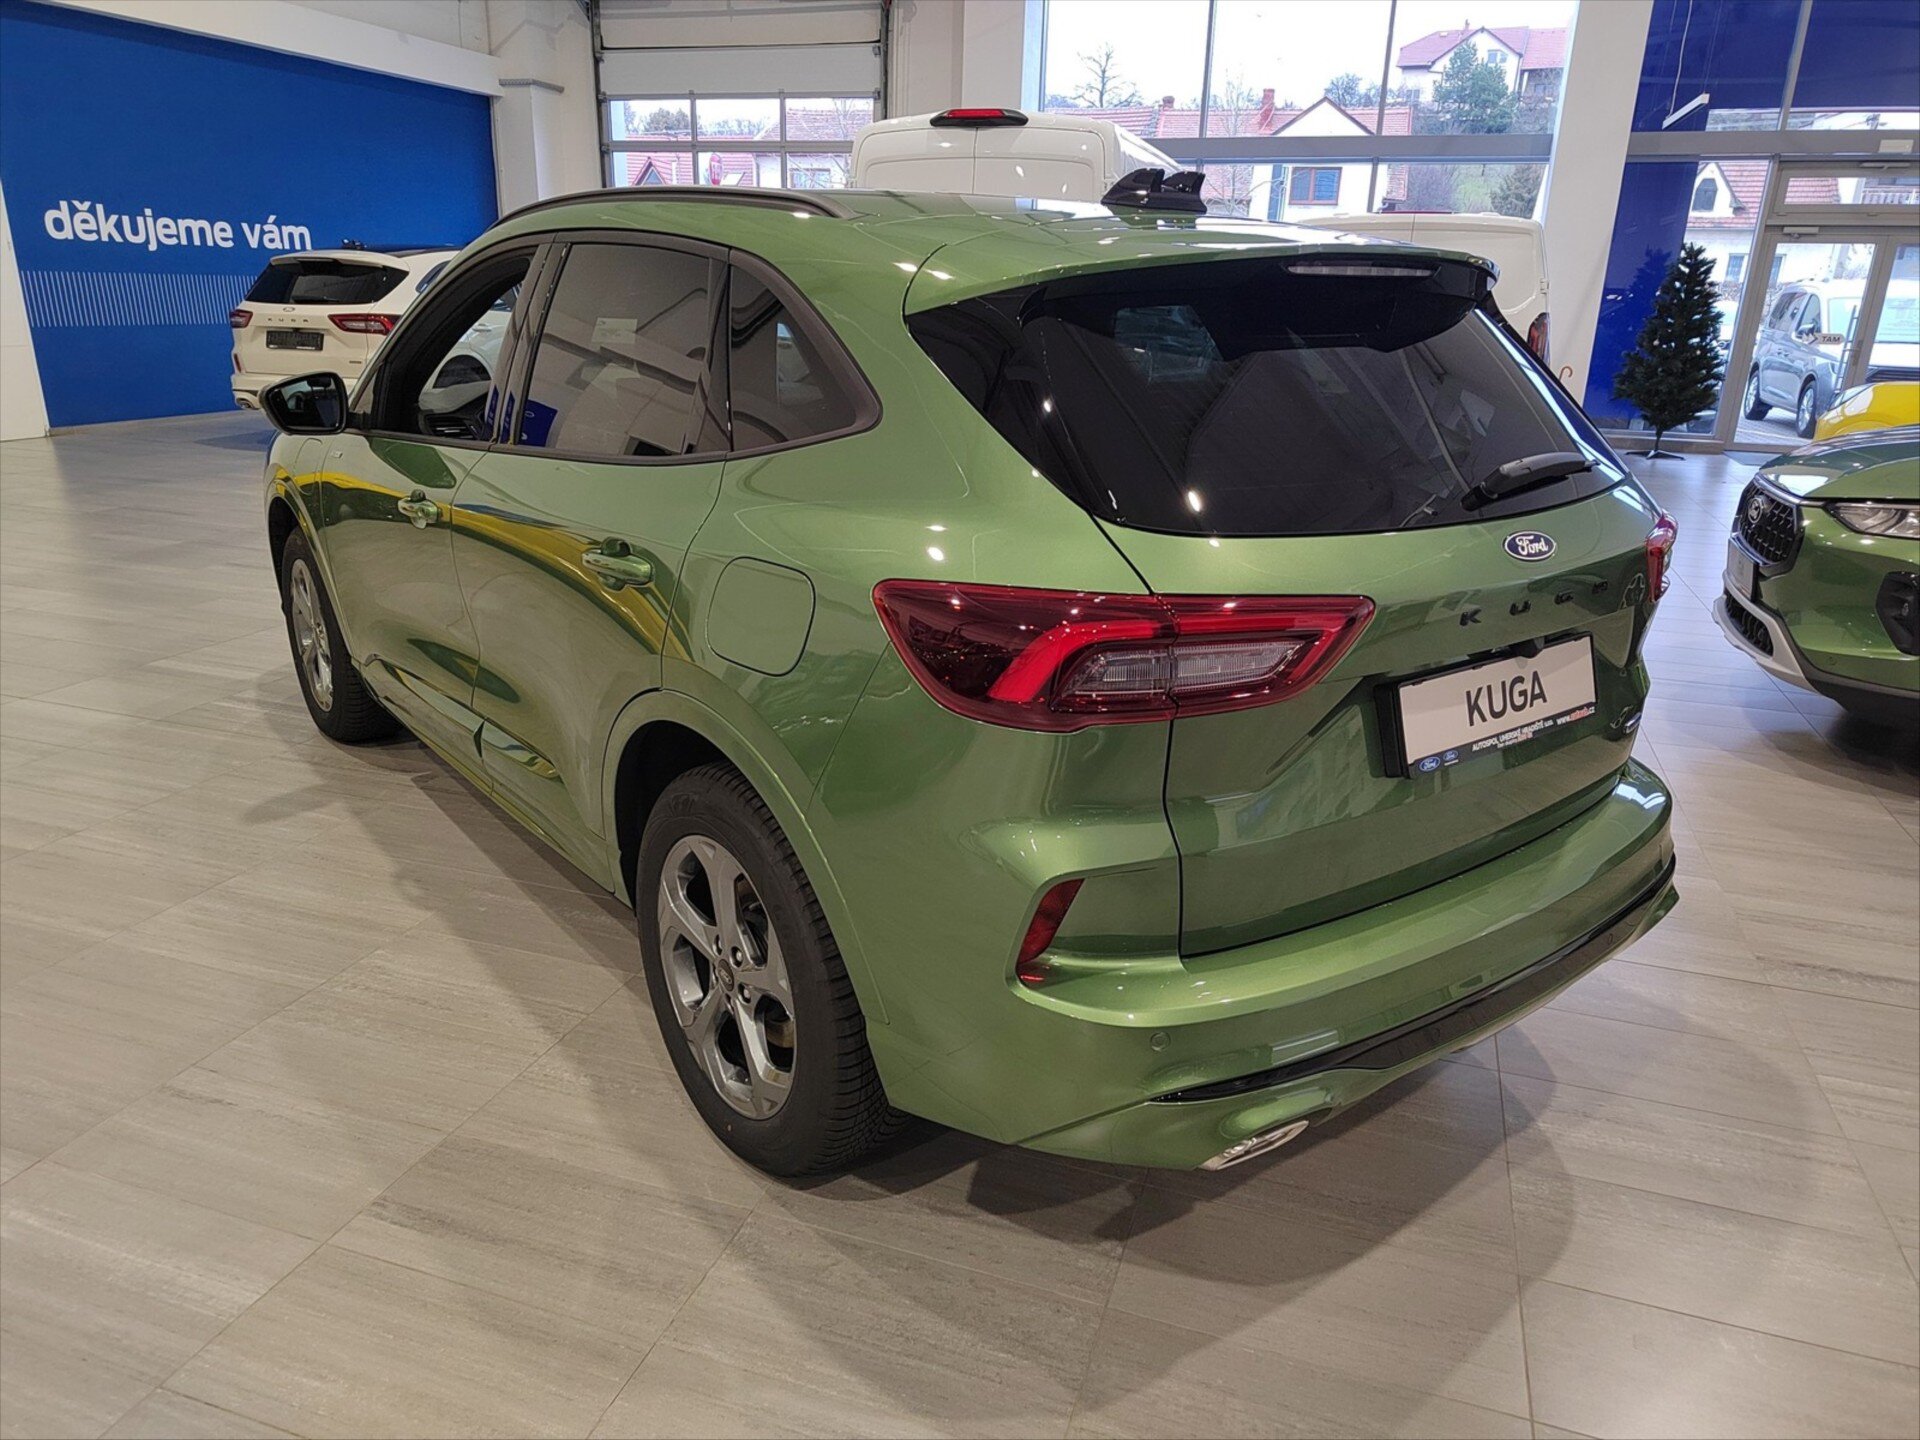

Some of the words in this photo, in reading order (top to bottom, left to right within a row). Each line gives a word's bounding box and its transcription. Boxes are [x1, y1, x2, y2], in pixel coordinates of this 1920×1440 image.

[44, 200, 235, 251] děkujeme
[241, 215, 313, 250] vám
[1515, 535, 1549, 556] Ford
[1459, 580, 1609, 627] KUGA
[1466, 670, 1548, 727] KUGA
[1472, 737, 1500, 752] AUTOSPOL
